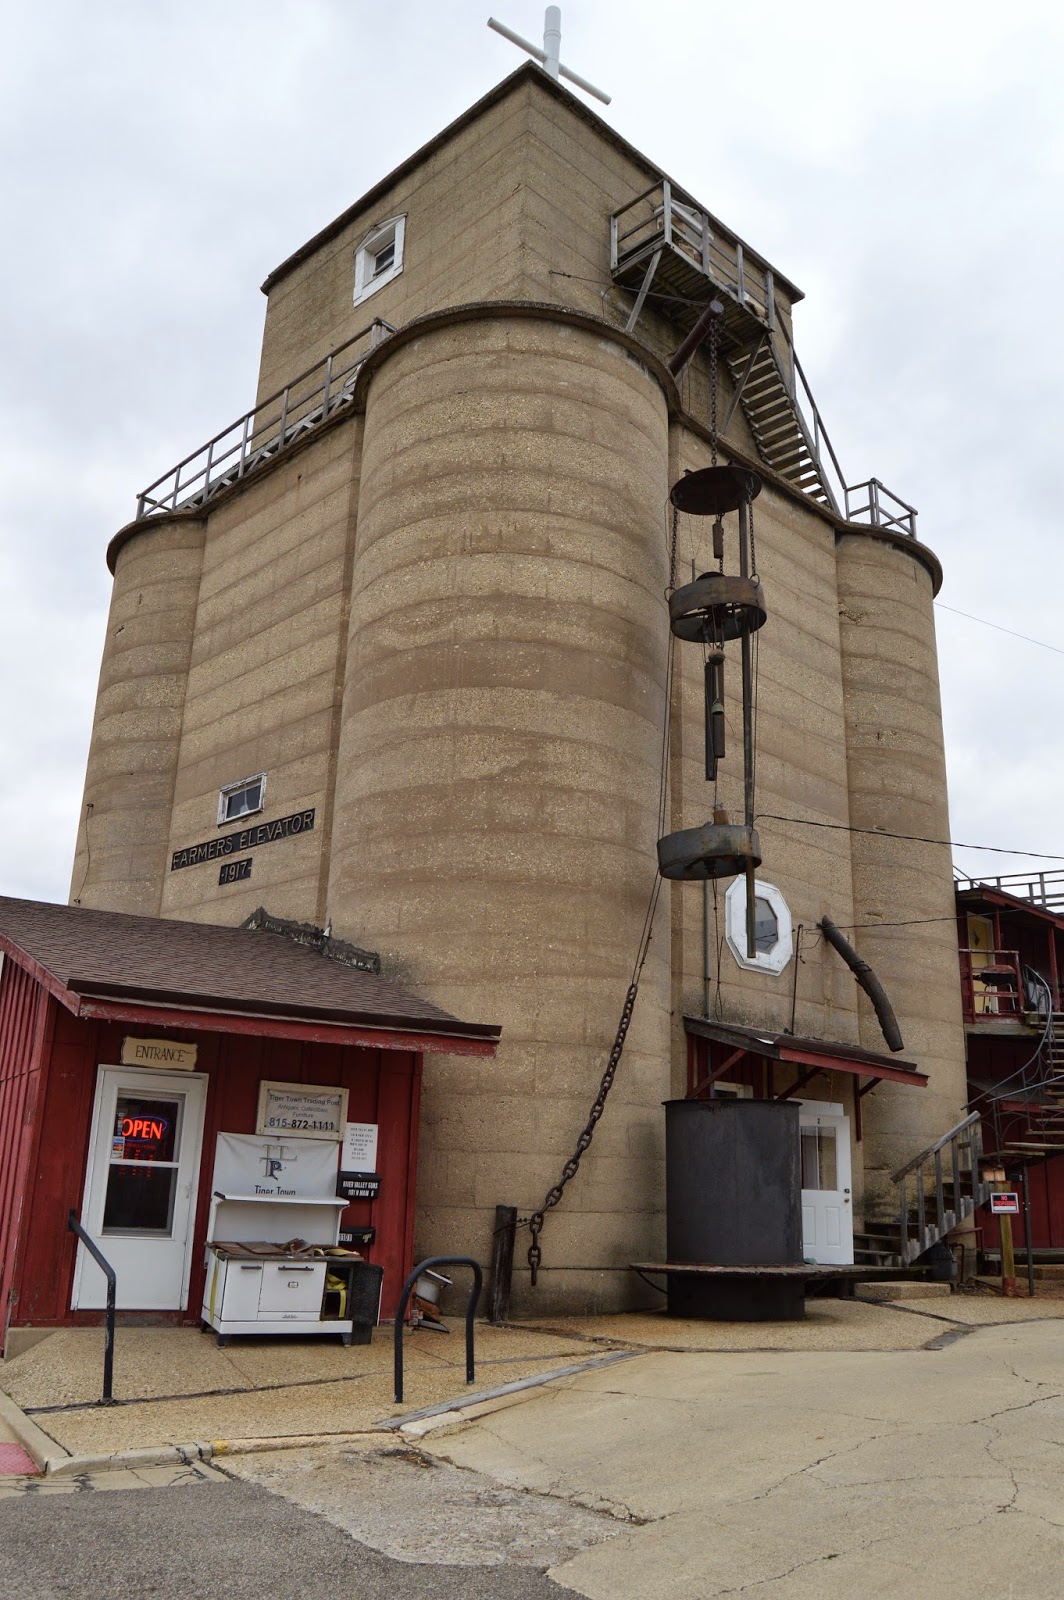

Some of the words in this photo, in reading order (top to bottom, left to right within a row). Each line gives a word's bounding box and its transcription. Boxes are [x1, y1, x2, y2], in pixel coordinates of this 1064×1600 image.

[173, 837, 233, 868] FARMERS
[239, 812, 314, 849] ELEVATOR
[135, 1045, 187, 1063] ENTRANCE
[269, 1094, 284, 1102] Tiger
[304, 1097, 325, 1105] Trading
[121, 1118, 163, 1140] OPEN
[269, 1117, 335, 1131] 815-872-1111
